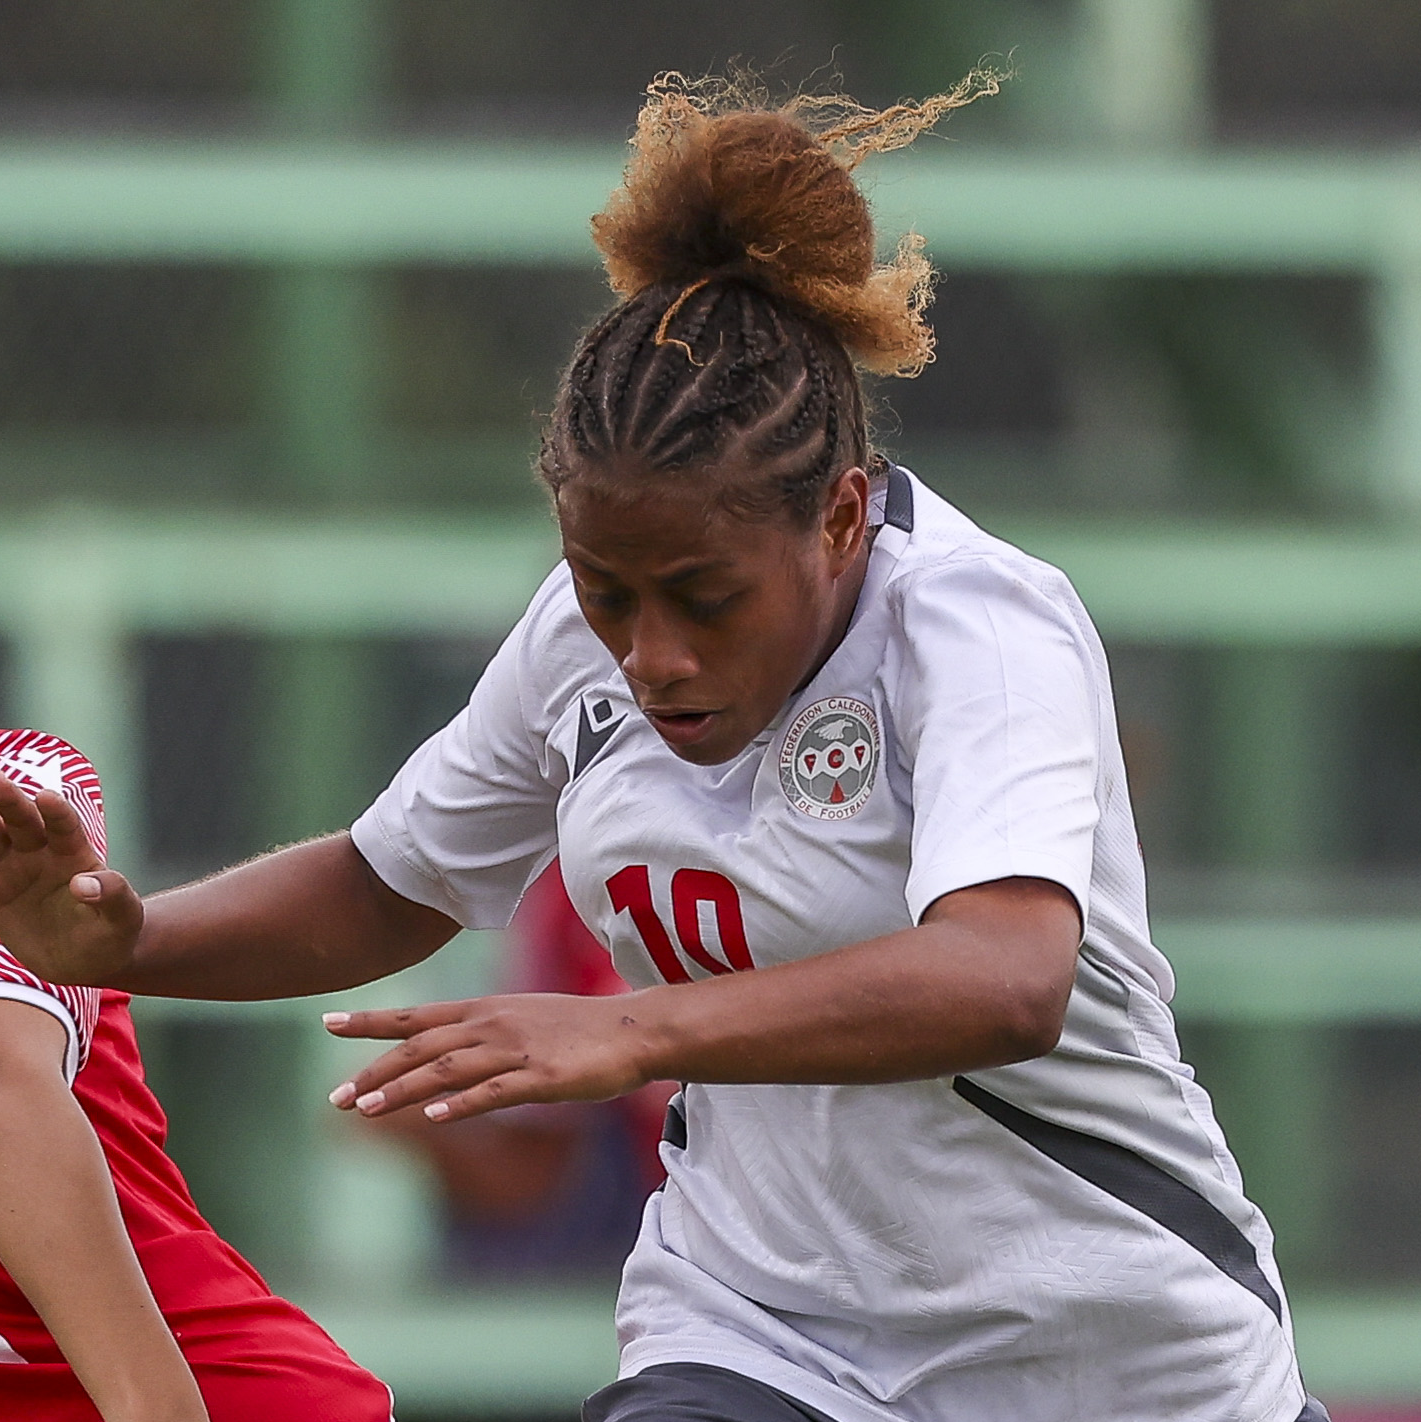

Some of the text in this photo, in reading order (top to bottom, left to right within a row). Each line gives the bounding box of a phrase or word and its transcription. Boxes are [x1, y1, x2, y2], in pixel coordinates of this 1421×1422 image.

[798, 793, 870, 819] DE FOOTBALL
[605, 864, 757, 985] 10
